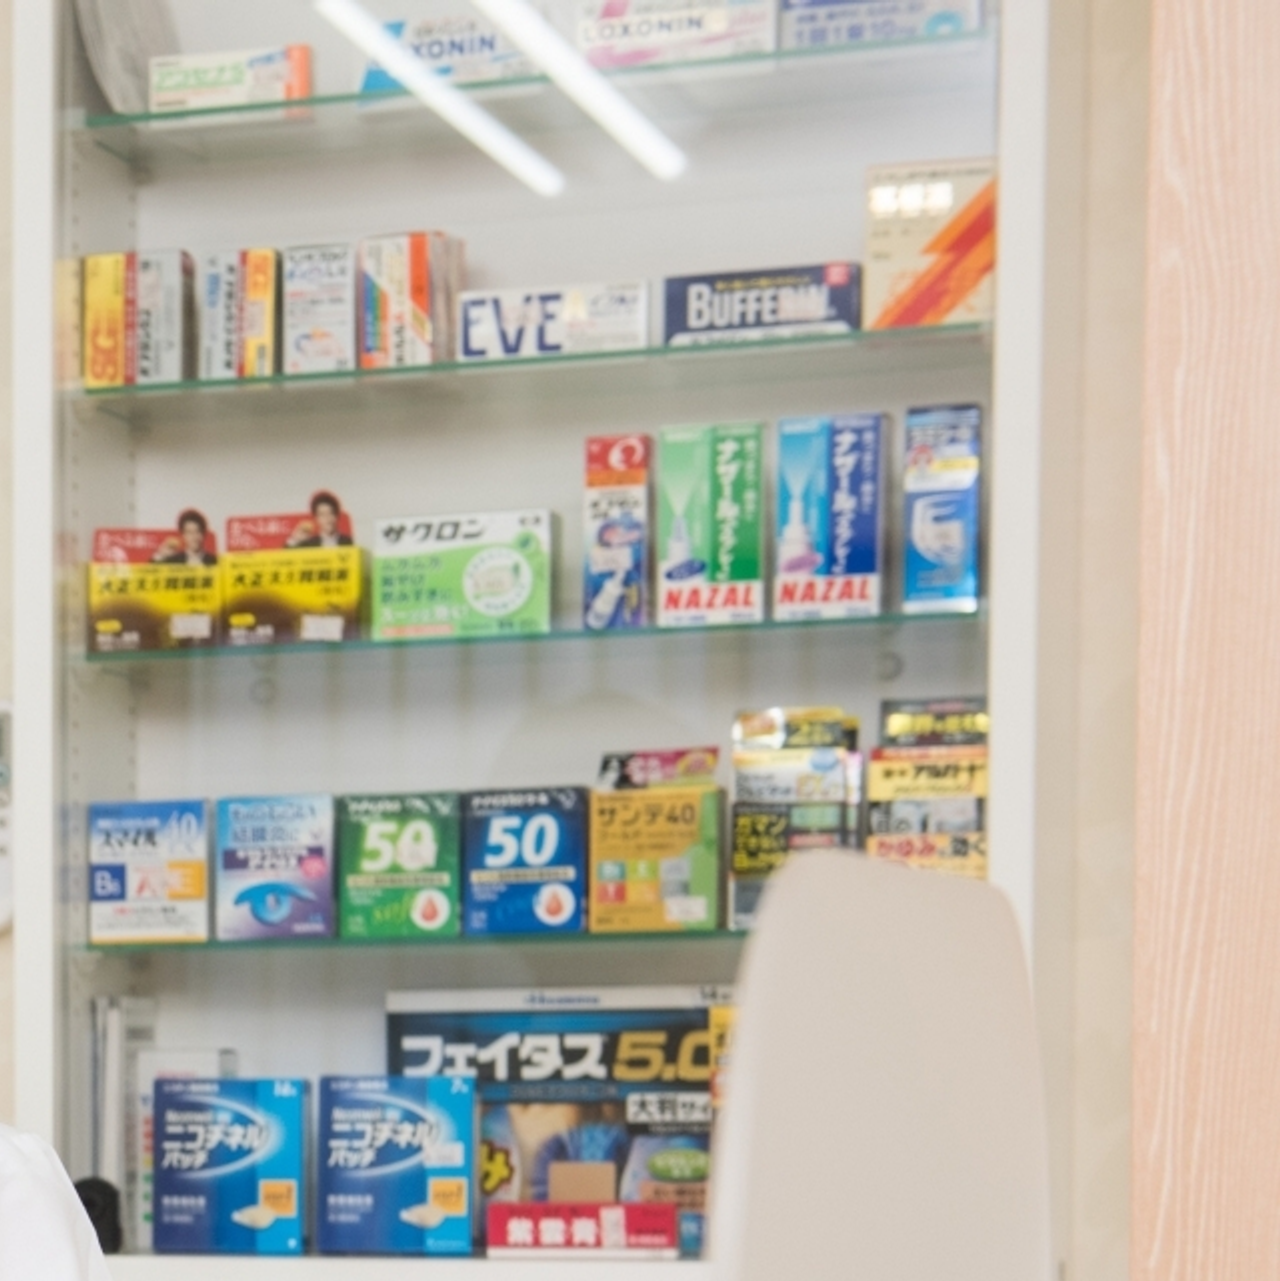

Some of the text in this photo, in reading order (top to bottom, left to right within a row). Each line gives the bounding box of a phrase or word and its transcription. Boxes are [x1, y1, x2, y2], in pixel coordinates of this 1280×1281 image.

[409, 35, 497, 60] XONIN
[686, 282, 830, 330] BUFFE
[462, 293, 563, 358] EVE
[382, 520, 484, 543] サクロン
[664, 584, 756, 613] NAZAL
[780, 576, 870, 605] NAZAL
[598, 804, 696, 827] サンテ40
[102, 828, 158, 848] スマイル
[360, 819, 437, 872] 50
[483, 813, 560, 868] 50
[401, 1029, 712, 1082] フェイタス 5.0
[631, 1094, 708, 1120] 大判サイ
[161, 1123, 268, 1152] ニコチネル
[327, 1122, 437, 1152] ニコチネル
[161, 1150, 209, 1170] パッチ
[327, 1150, 376, 1169] パッチ
